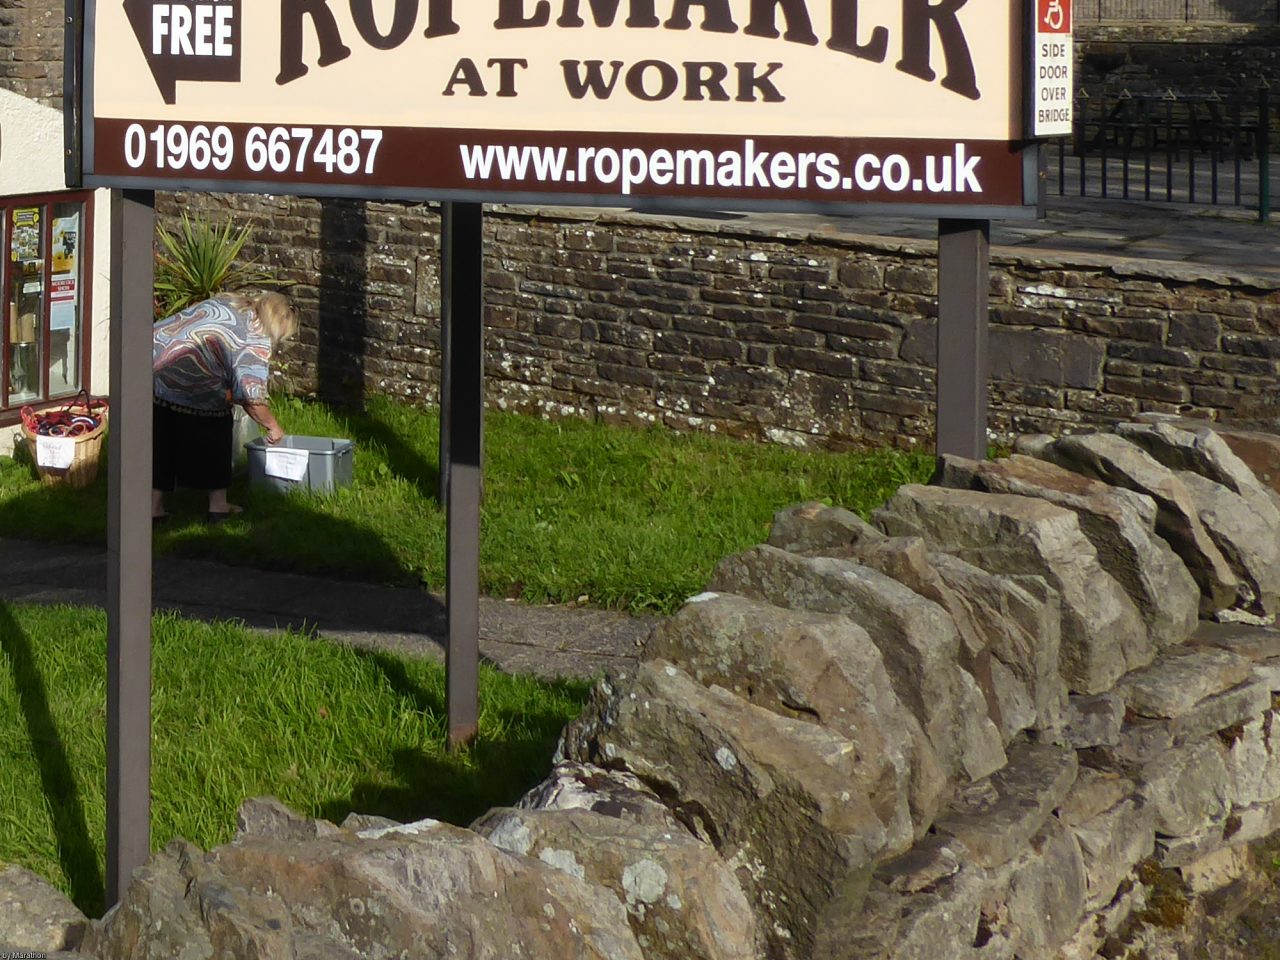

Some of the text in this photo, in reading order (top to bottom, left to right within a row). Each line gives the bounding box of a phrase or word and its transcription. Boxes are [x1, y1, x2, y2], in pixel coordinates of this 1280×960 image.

[152, 3, 234, 57] FREE
[1041, 44, 1065, 58] SIDE
[441, 57, 786, 103] AT WORK
[1039, 66, 1067, 79] DOOR
[1041, 87, 1066, 101] OVER
[1039, 109, 1070, 123] BRIDGE
[124, 123, 383, 175] 01969 667487
[459, 138, 983, 195] www.ropemakers.co.uk
